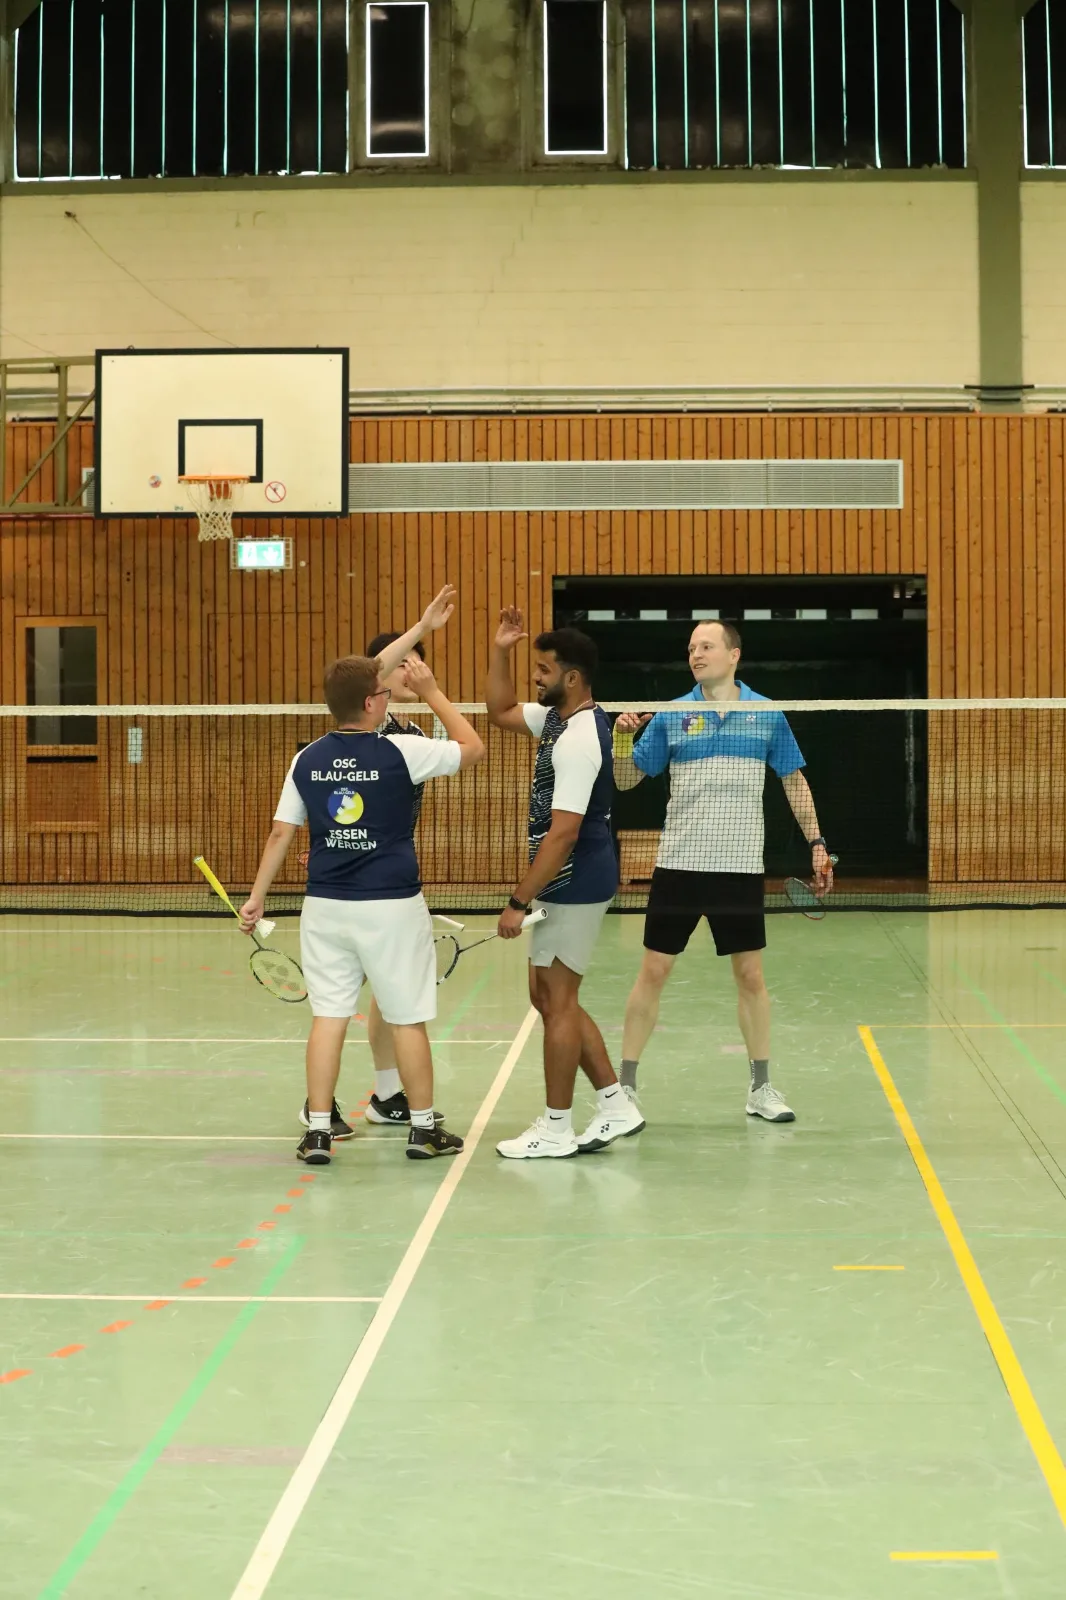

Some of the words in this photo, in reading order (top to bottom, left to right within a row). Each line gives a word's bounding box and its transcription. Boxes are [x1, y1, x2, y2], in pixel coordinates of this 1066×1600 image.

[333, 758, 357, 769] OSC
[311, 770, 379, 781] BLAU-GELB
[329, 829, 367, 839] ESSEN
[325, 837, 376, 850] WERDEN
